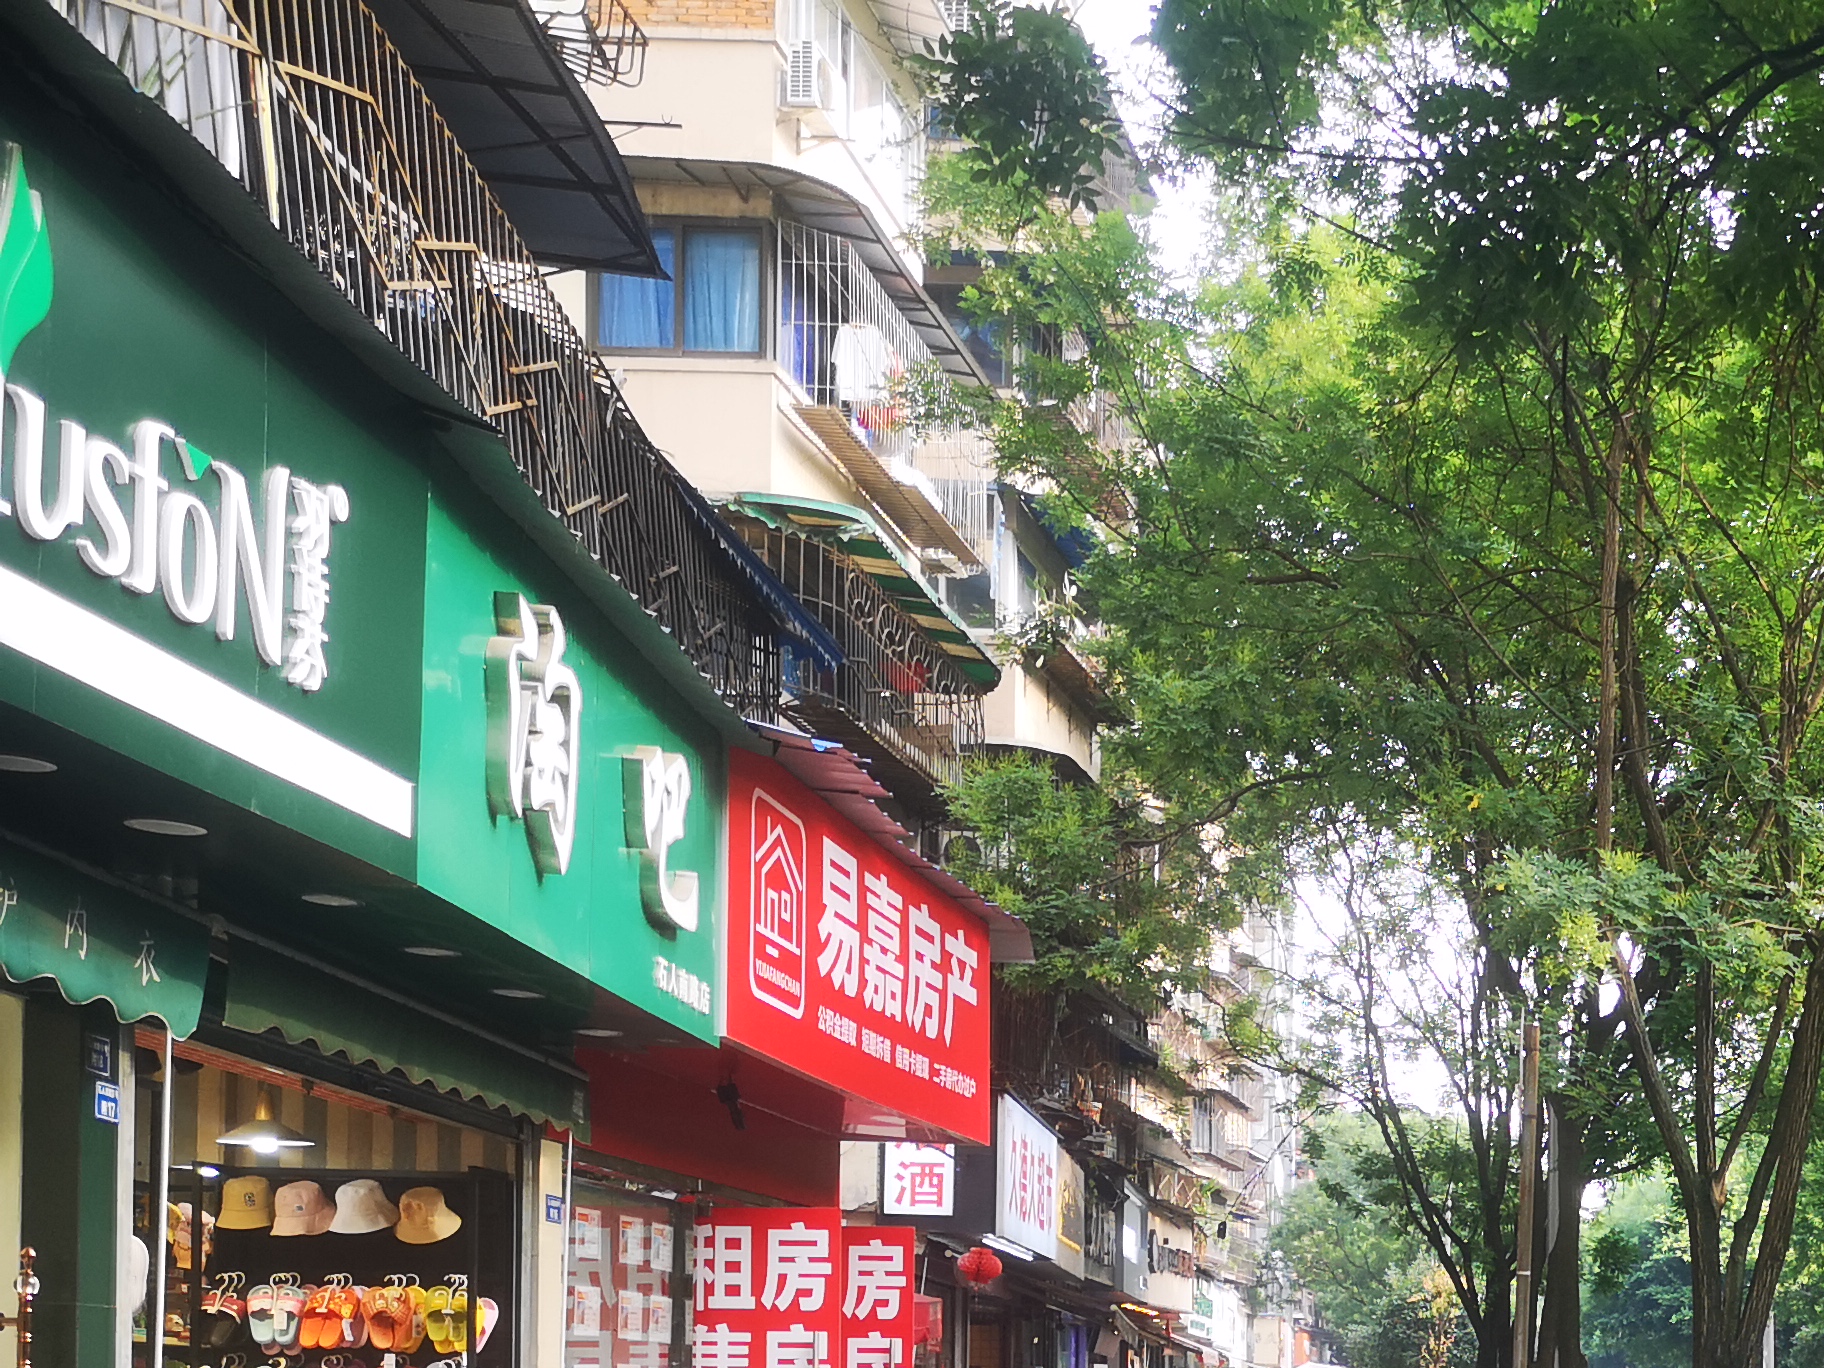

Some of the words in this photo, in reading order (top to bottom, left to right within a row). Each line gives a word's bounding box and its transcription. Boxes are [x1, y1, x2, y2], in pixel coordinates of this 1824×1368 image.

[816, 835, 978, 1047] 易嘉房产
[817, 1005, 858, 1048] 公积金提取
[932, 1063, 977, 1098] 二手房代办过户
[693, 1222, 833, 1311] 租房
